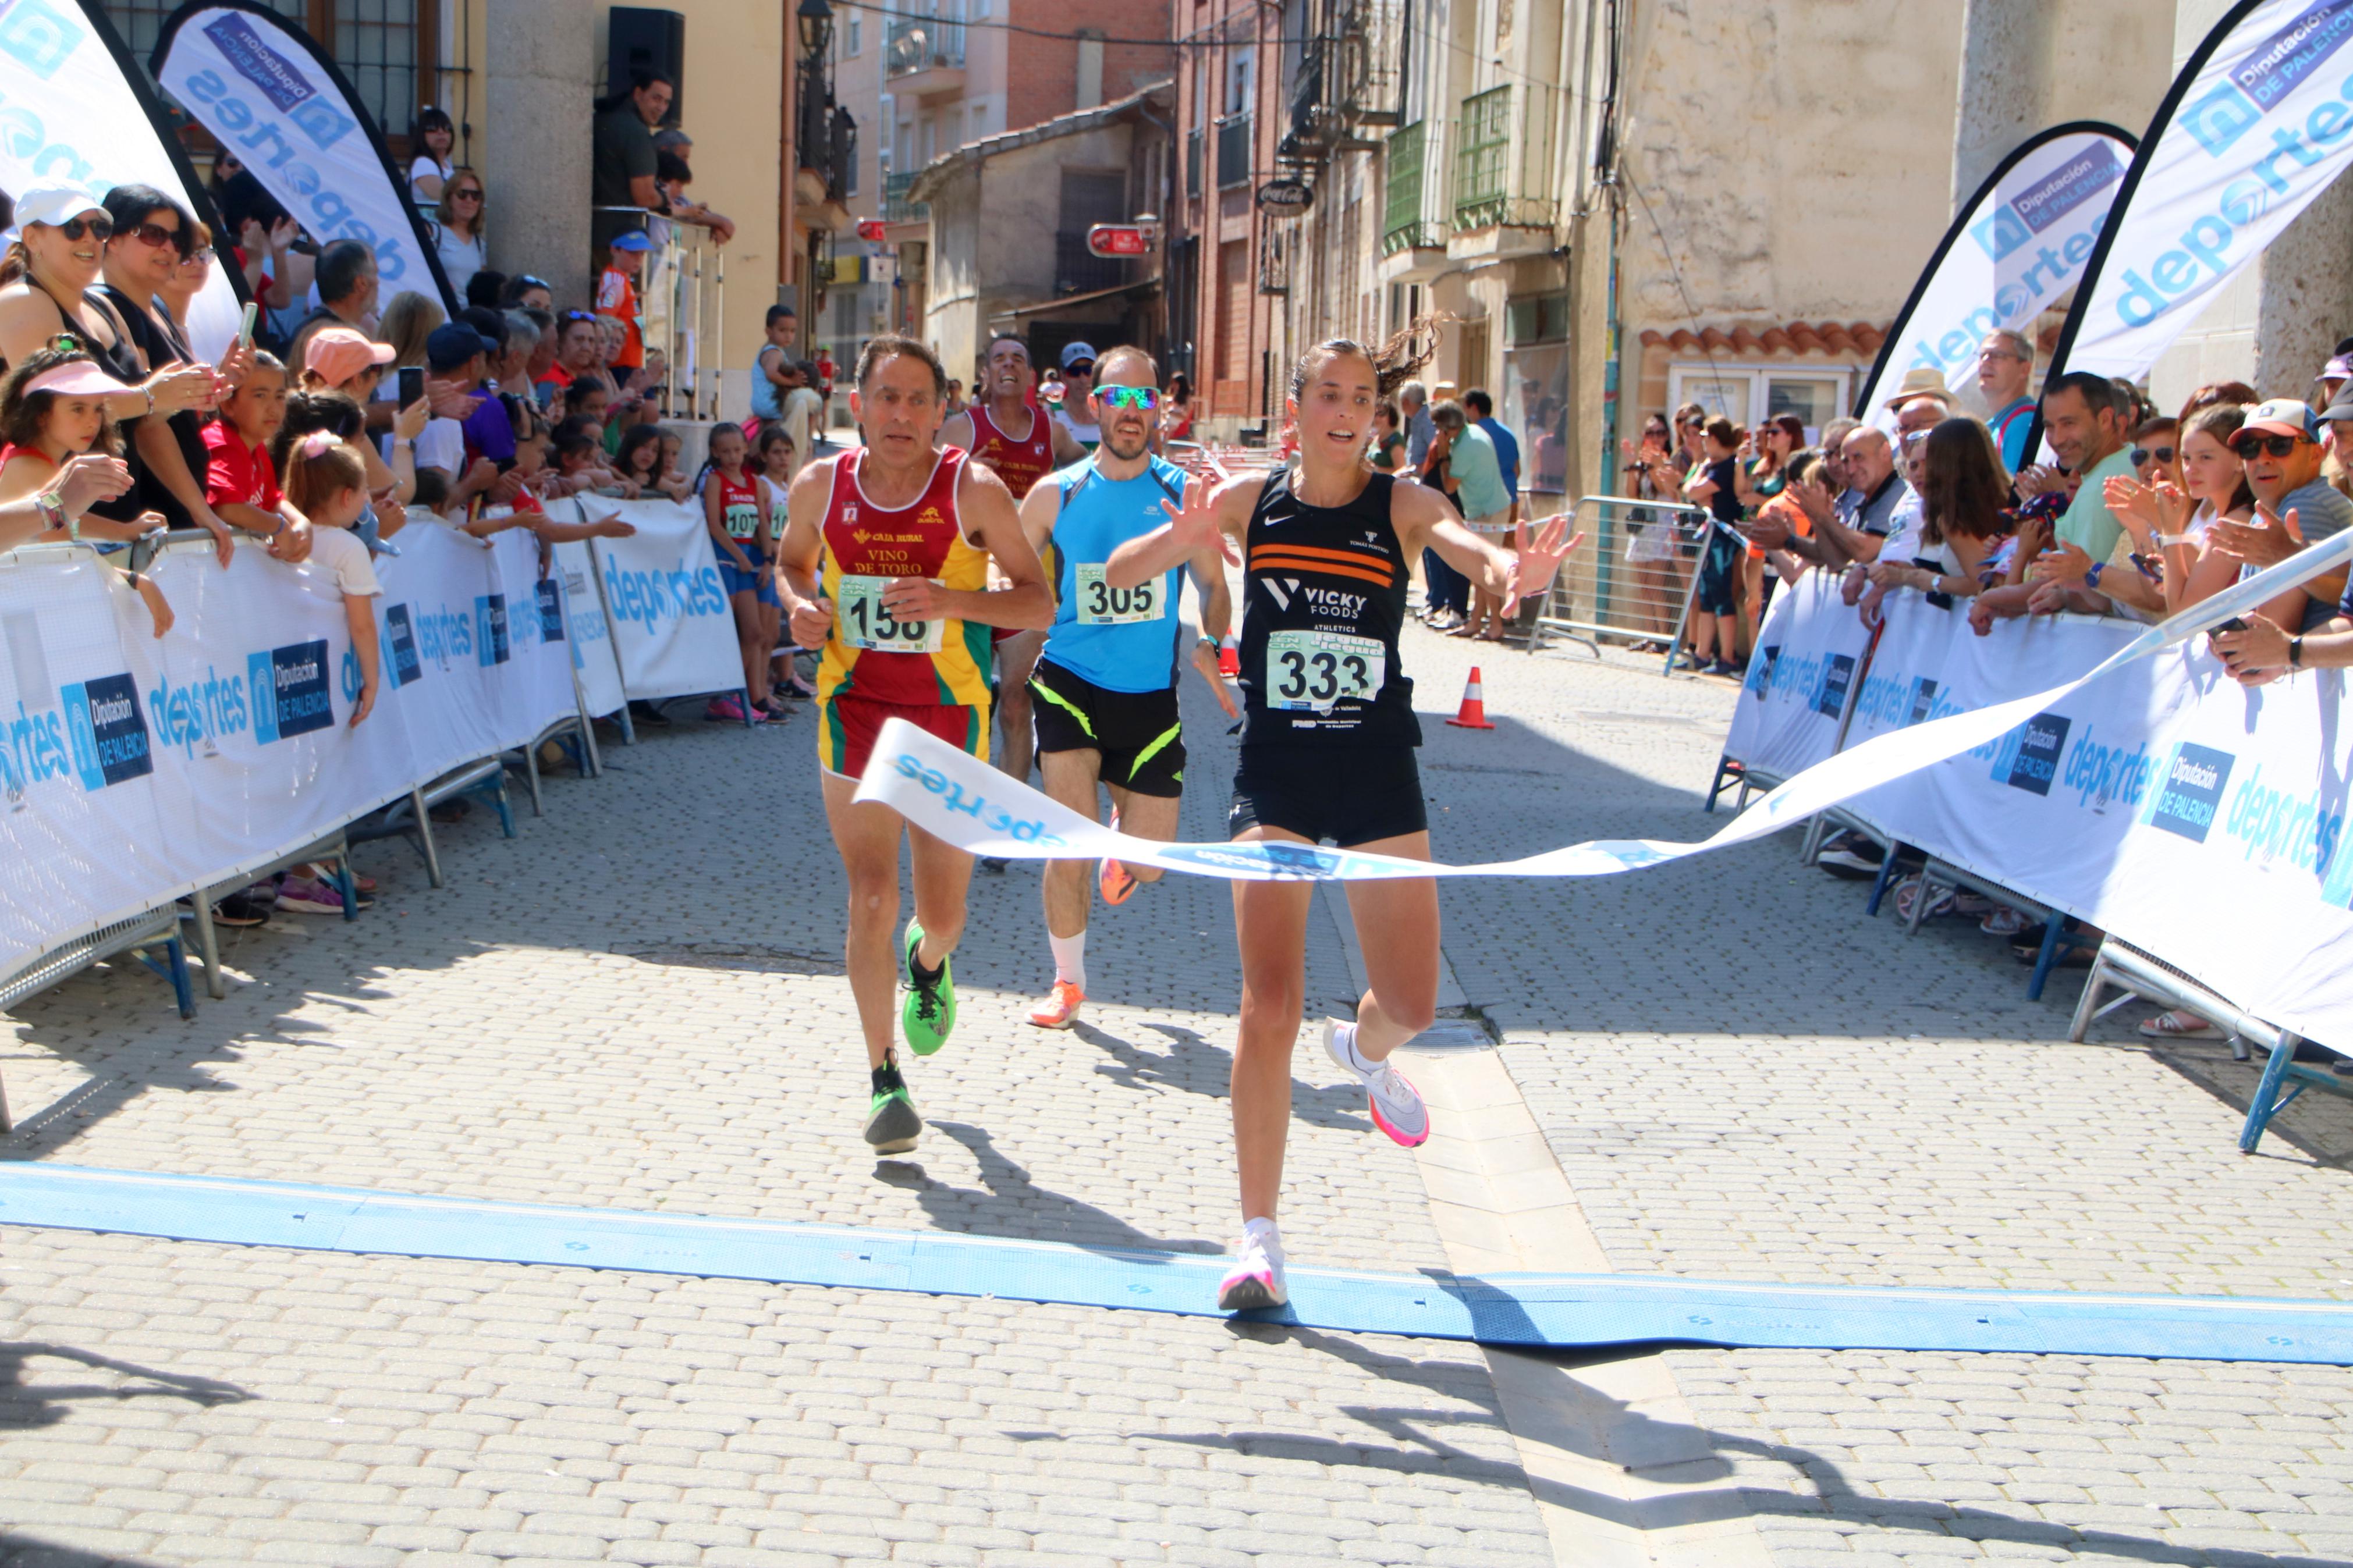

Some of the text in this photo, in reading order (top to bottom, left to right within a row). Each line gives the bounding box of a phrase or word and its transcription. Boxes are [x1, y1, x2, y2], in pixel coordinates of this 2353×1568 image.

[2240, 5, 2332, 87] Diputación
[2254, 75, 2284, 104] DE
[2018, 158, 2092, 214] Diputación
[2029, 162, 2120, 228] DE PALENCIA
[868, 549, 908, 561] VINO
[873, 532, 924, 543] CAJA RURAL
[1350, 539, 1368, 548] TOMÁS
[854, 563, 922, 575] DE TORO
[605, 552, 725, 636] deportes
[1088, 580, 1152, 615] 305
[1304, 587, 1368, 611] VICKY
[1311, 605, 1359, 620] FOODS
[1314, 624, 1356, 633] ATHLETICS
[275, 656, 320, 692] Diputación
[1279, 650, 1369, 701] 333
[90, 692, 133, 730] Diputación
[149, 666, 247, 760] deportes
[279, 689, 329, 722] DE PALENCIA
[99, 731, 150, 767] DE PALENCIA
[2064, 724, 2162, 808] deportes
[2171, 756, 2219, 791] Diputación
[895, 753, 1071, 848] eportes
[2157, 791, 2215, 829] DE PALENCIA
[2226, 762, 2341, 875] deportes
